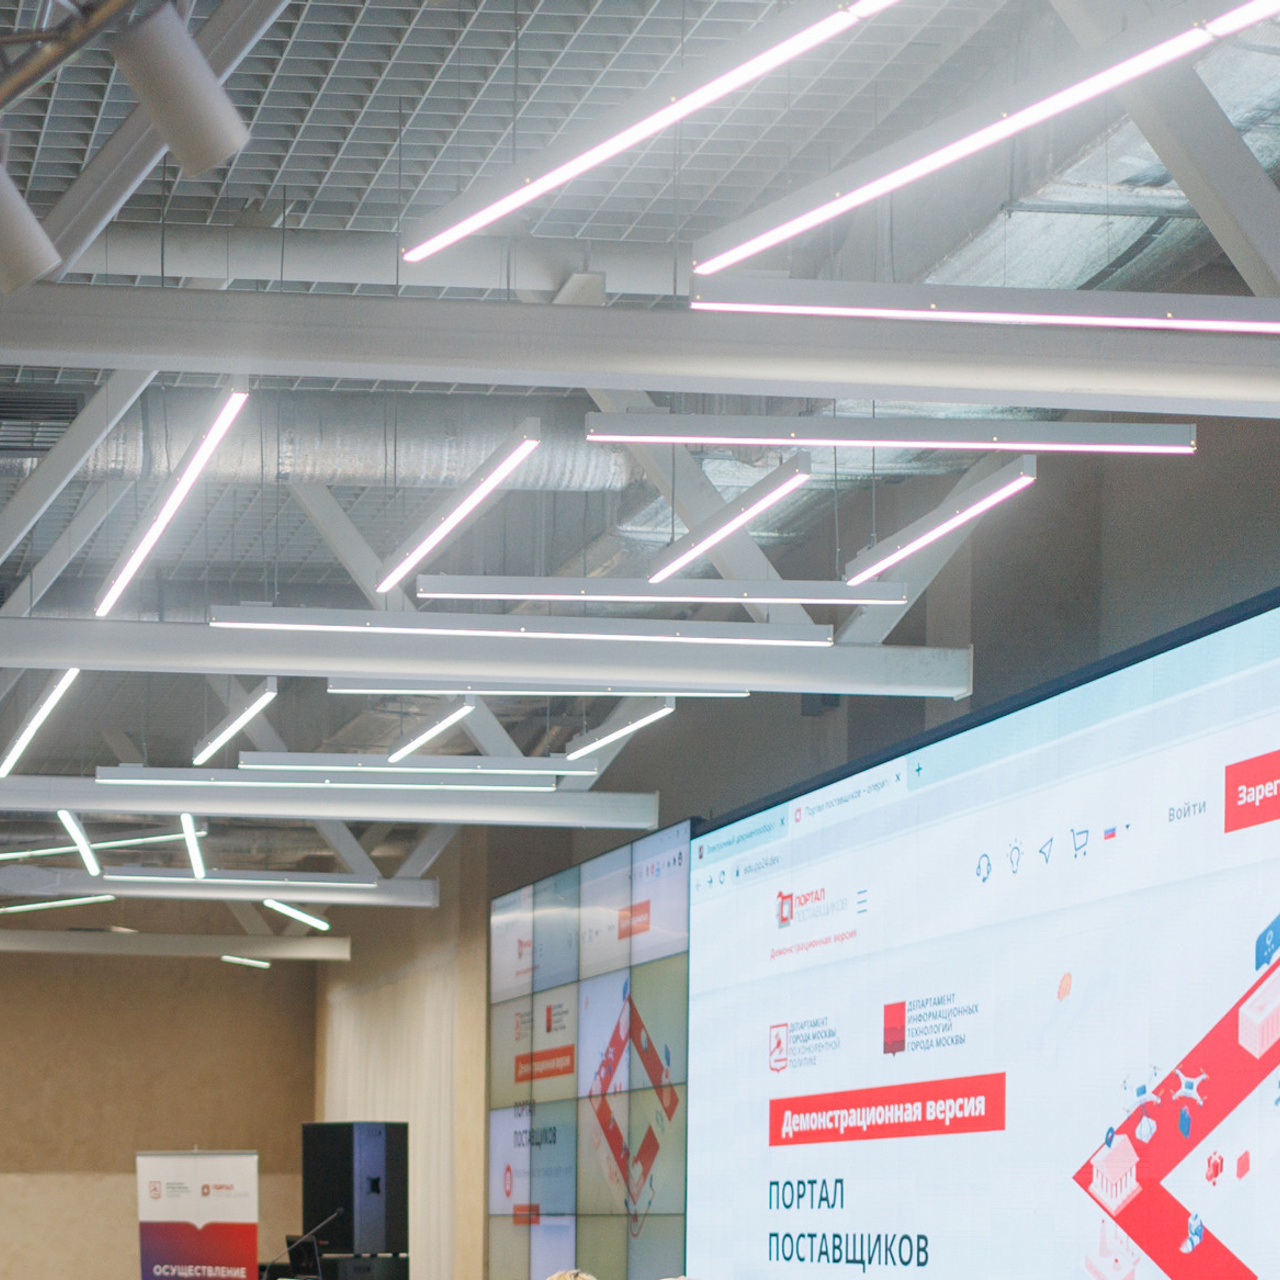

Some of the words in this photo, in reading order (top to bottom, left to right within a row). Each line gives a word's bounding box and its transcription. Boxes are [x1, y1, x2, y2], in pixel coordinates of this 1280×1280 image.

[1168, 801, 1207, 822] Войти
[795, 888, 825, 908] ПОРТАЛ
[833, 930, 857, 944] версия
[907, 993, 956, 1012] ДЕПАРТАМЕНТ
[907, 1003, 979, 1024] ИНФОРМАЦИОННЫХ
[789, 1016, 828, 1033] ДЕПАРТАМЕНТ
[907, 1021, 953, 1038] ТЕХНОЛОГИЙ
[790, 1033, 811, 1044] ГОРОДА
[812, 1028, 837, 1040] МОСКВЫ
[907, 1037, 934, 1052] ГОРОДА
[935, 1034, 967, 1048] МОСКВЫ
[781, 1102, 922, 1139] Демонстрационная
[926, 1095, 986, 1126] версия
[769, 1178, 844, 1210] ПОРТАЛ
[769, 1232, 929, 1274] ПОСТАВЩИКОВ
[153, 1264, 247, 1279] ОСУЩЕСТВЛЕНИЕ
